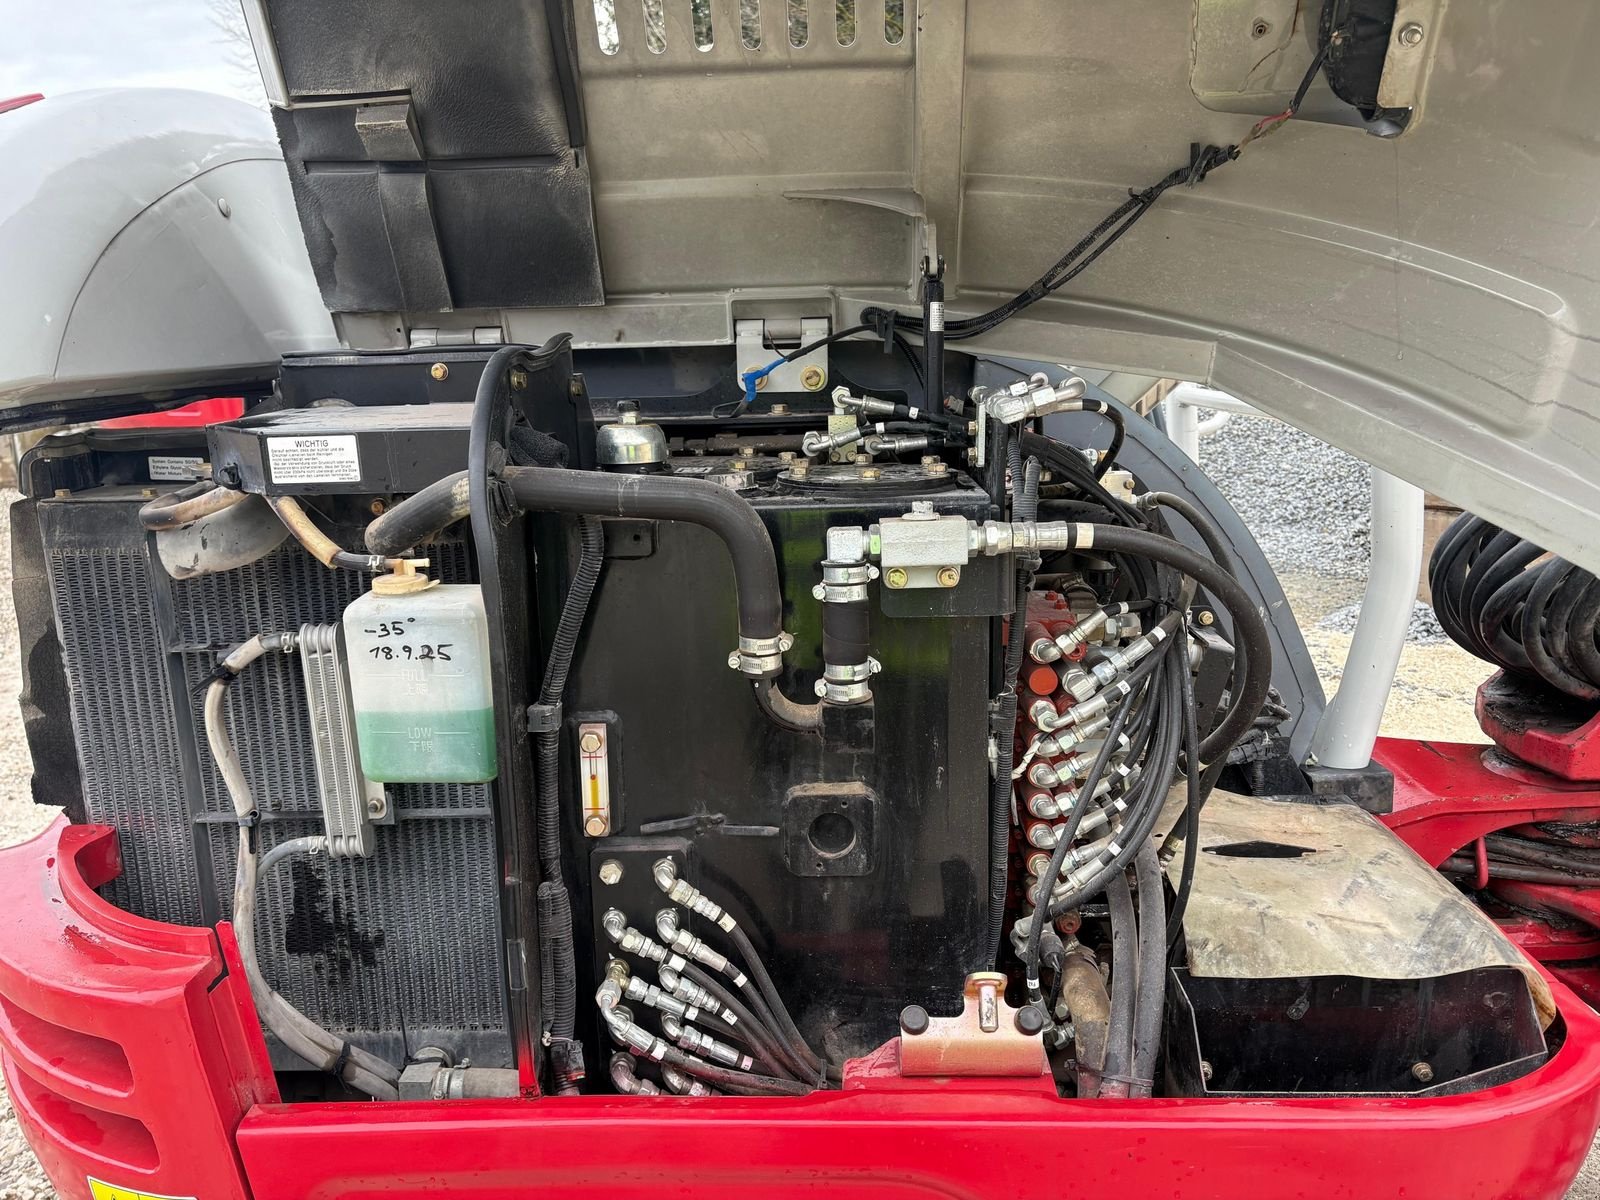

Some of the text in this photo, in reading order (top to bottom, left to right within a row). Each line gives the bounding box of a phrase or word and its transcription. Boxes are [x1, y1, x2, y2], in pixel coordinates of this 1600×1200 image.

[295, 440, 329, 448] WICHTIG
[364, 617, 416, 638] -35°
[369, 644, 453, 661] 18.9.25
[402, 669, 429, 682] FULL
[407, 727, 432, 739] LOW
